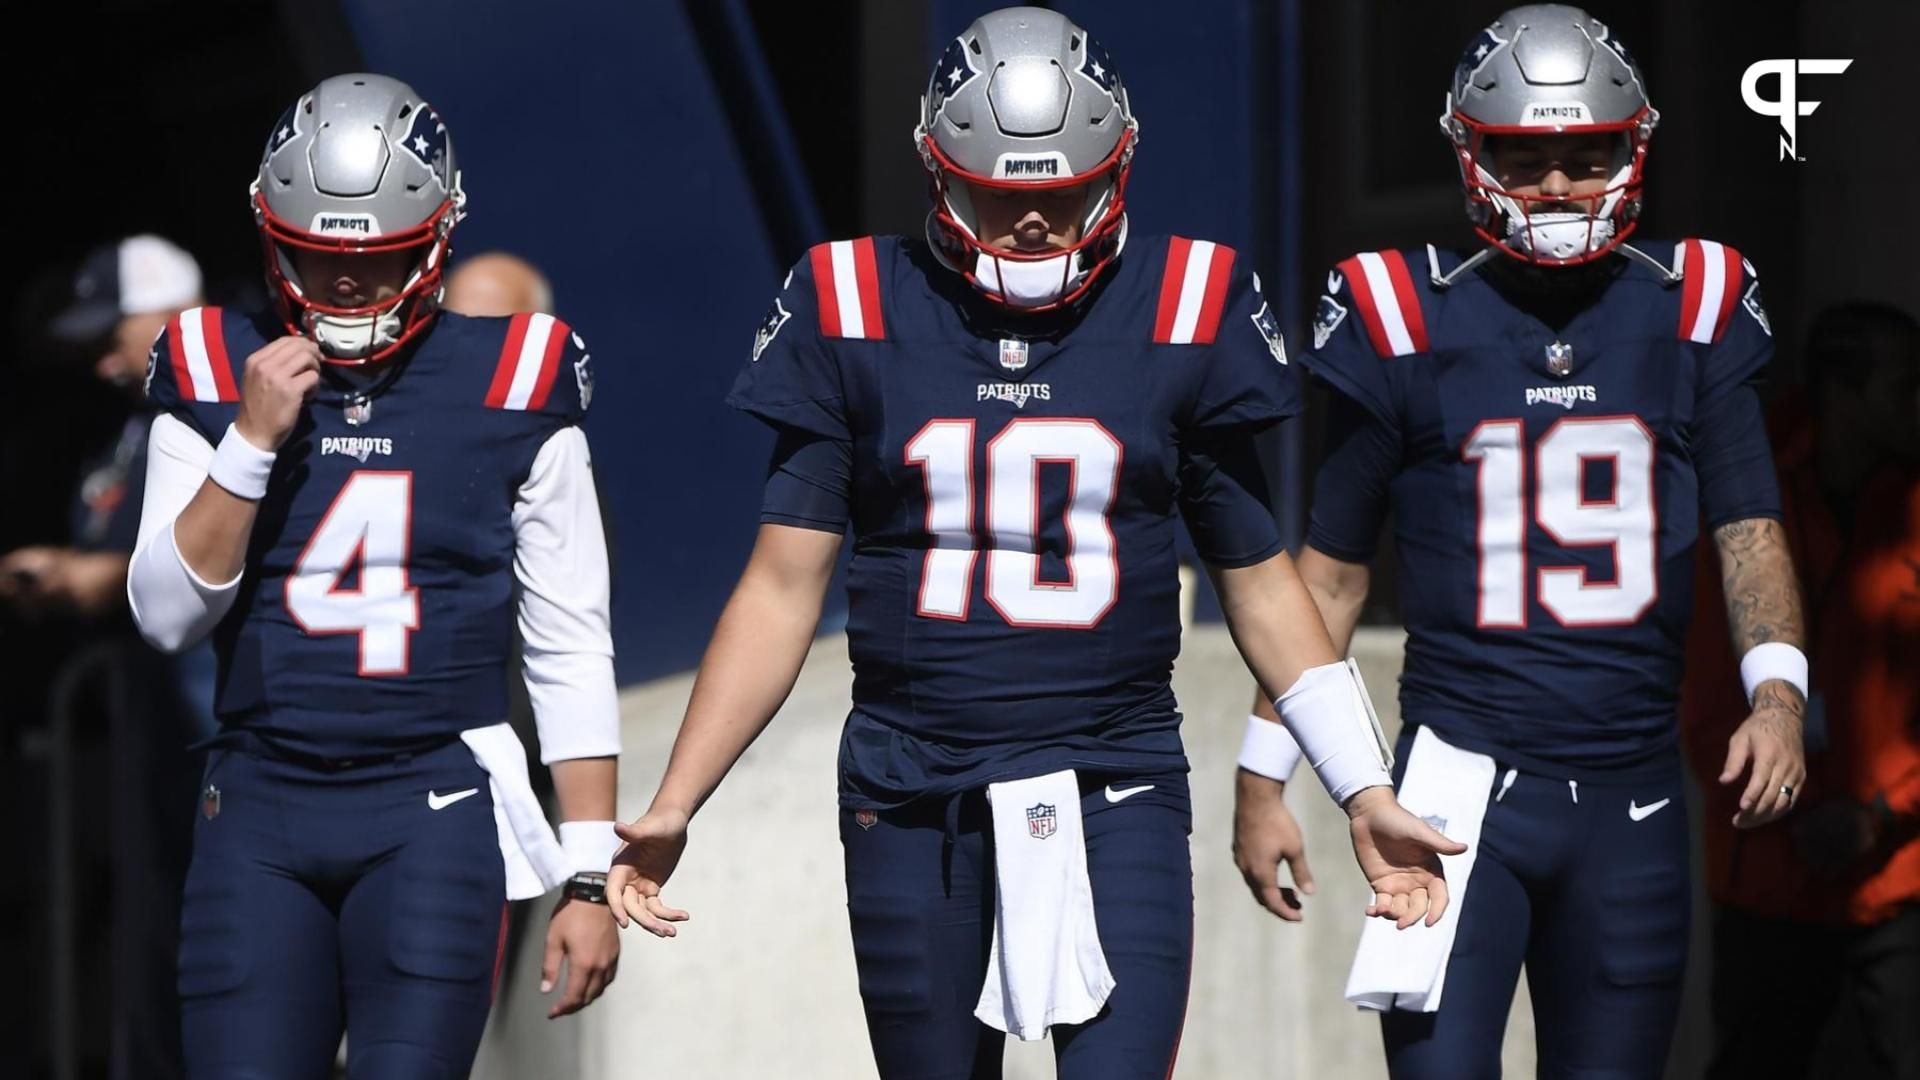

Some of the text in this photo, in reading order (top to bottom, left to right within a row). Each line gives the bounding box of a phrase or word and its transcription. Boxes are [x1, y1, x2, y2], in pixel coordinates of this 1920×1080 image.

[1532, 106, 1582, 119] PATRIOTS
[1004, 158, 1058, 177] PATRIOTS
[320, 217, 370, 233] PATRIOTS
[976, 383, 1051, 402] PATRIOTS
[1525, 385, 1597, 405] PATRIOTS
[320, 437, 393, 455] PATRIOTS
[904, 417, 1124, 629] 10
[1461, 413, 1658, 629] 19
[284, 469, 421, 677] 4
[1030, 818, 1057, 836] NFL
